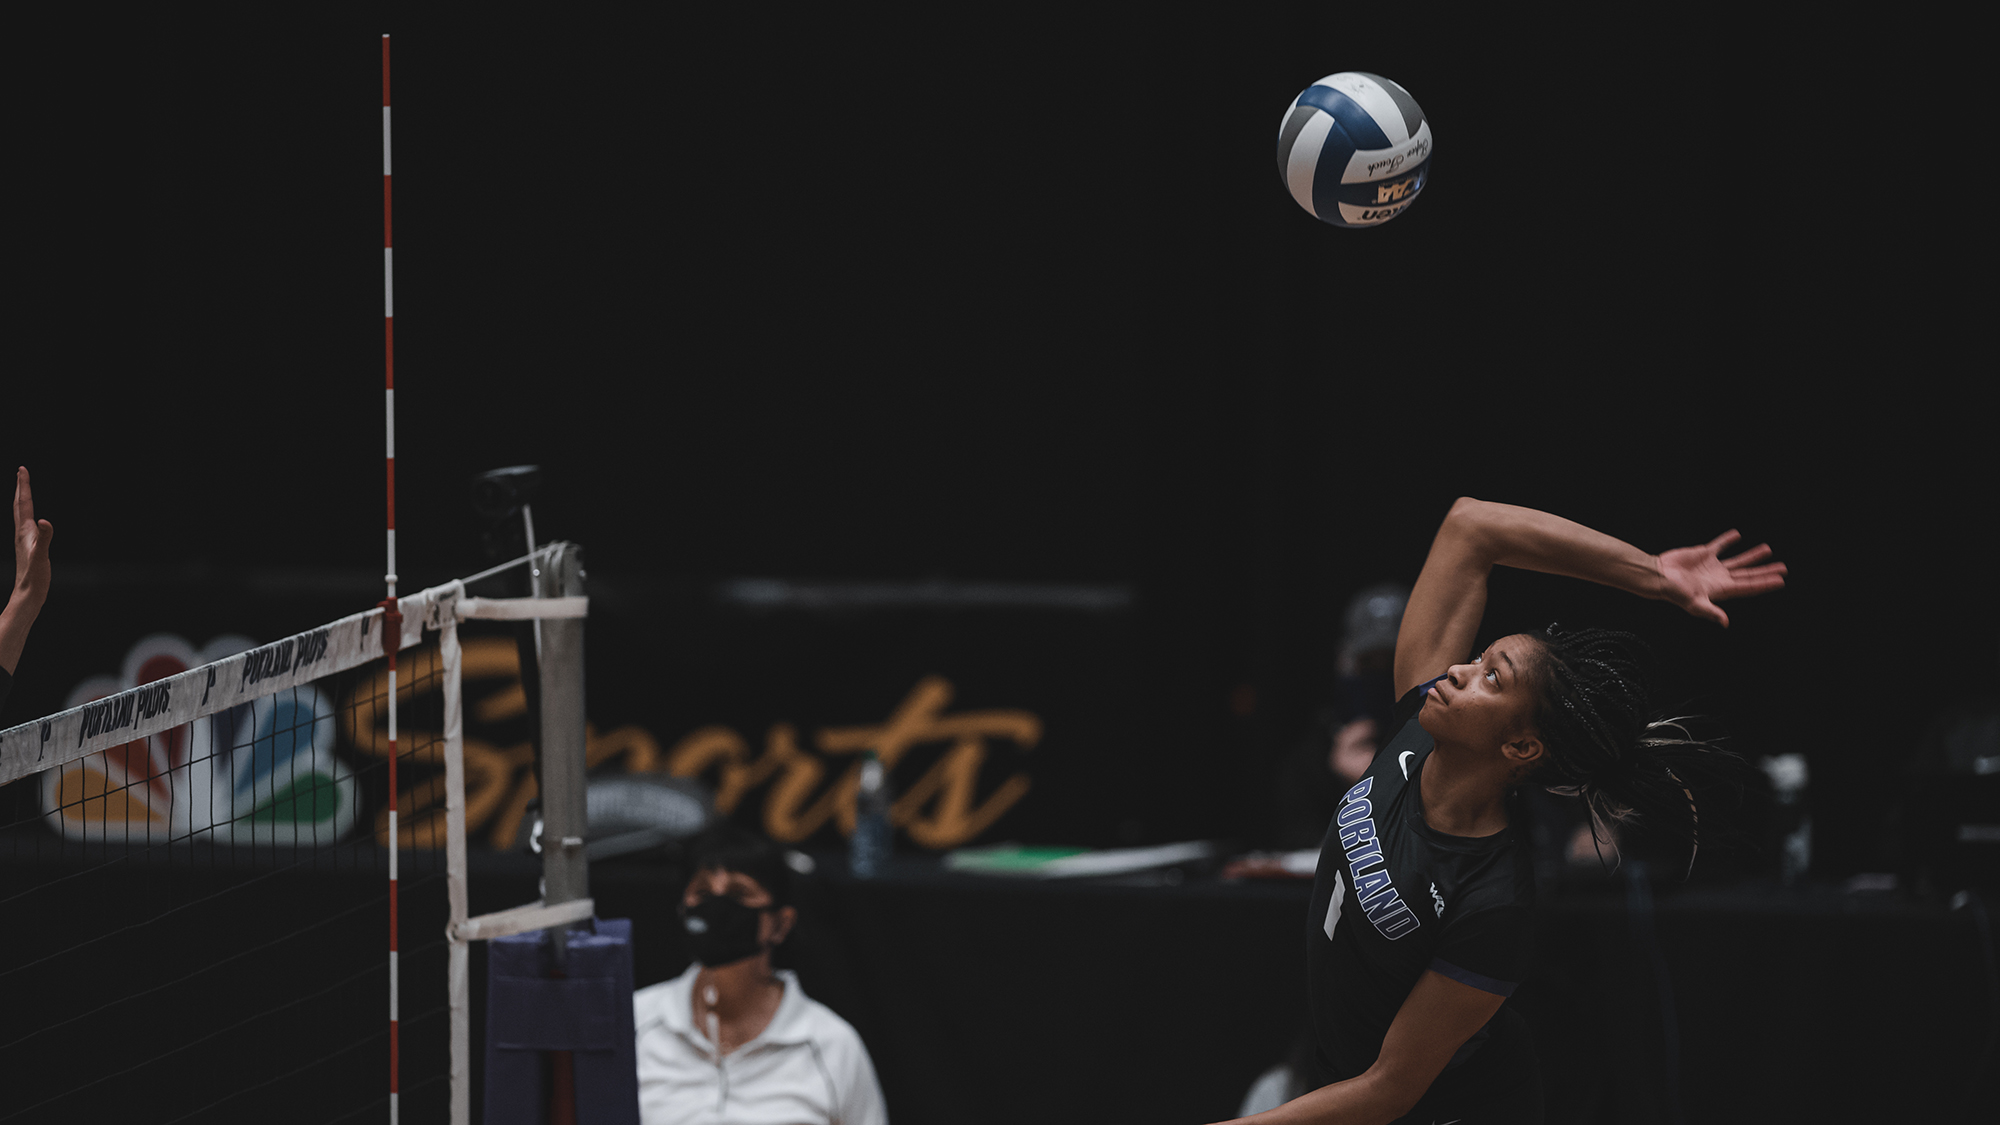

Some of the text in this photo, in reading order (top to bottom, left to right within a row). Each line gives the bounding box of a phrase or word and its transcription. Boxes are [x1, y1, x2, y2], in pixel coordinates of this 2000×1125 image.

[1367, 154, 1404, 177] Touch
[240, 628, 329, 693] PORTLAND PILOTS
[78, 681, 171, 748] PORTLAND PILOTS
[1337, 775, 1421, 941] PORTLAND
[1323, 869, 1347, 941] 1
